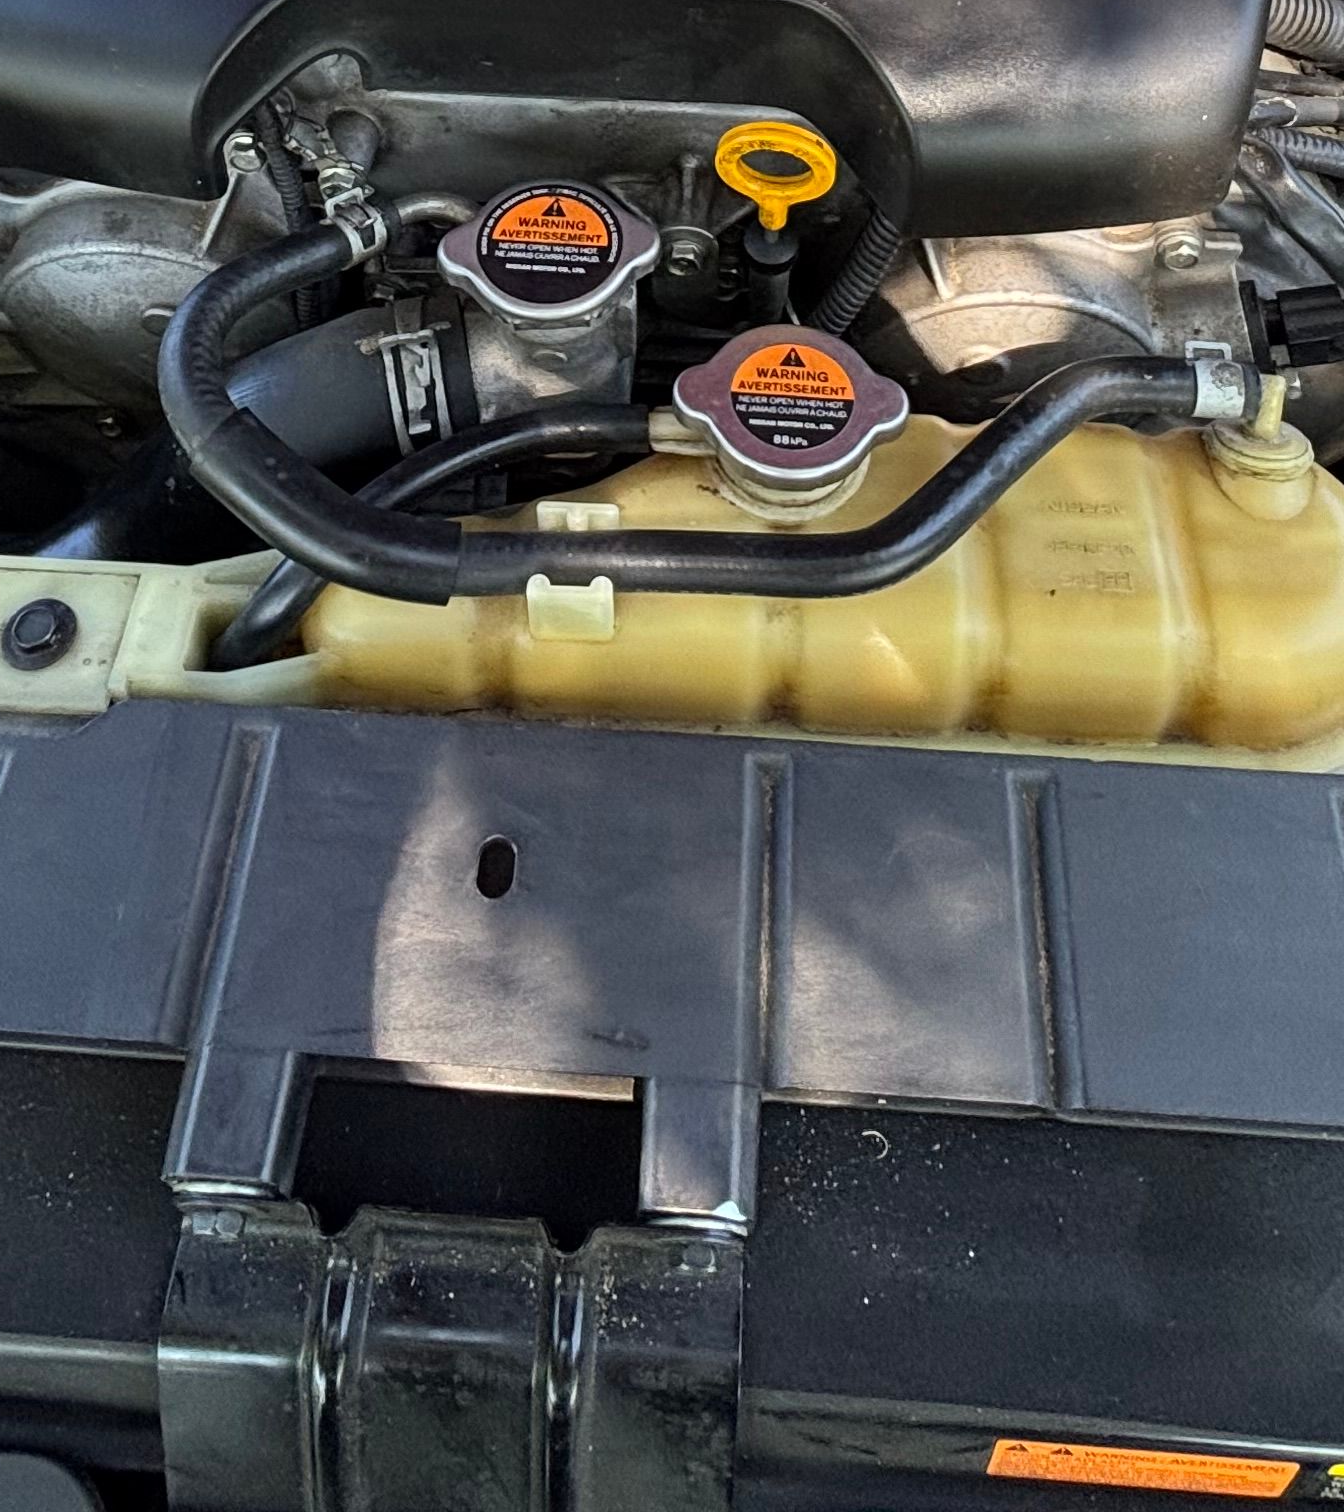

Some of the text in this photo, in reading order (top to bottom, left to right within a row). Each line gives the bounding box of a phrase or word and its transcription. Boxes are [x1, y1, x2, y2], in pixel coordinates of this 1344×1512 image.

[519, 217, 586, 230] WARNING
[499, 229, 603, 243] AVERTISSEMENT
[756, 367, 829, 382] WARNING
[738, 380, 847, 396] AVERTISSEMENT
[738, 395, 767, 403] NEVER
[769, 397, 795, 405] OPEN
[796, 399, 824, 407] WHEN
